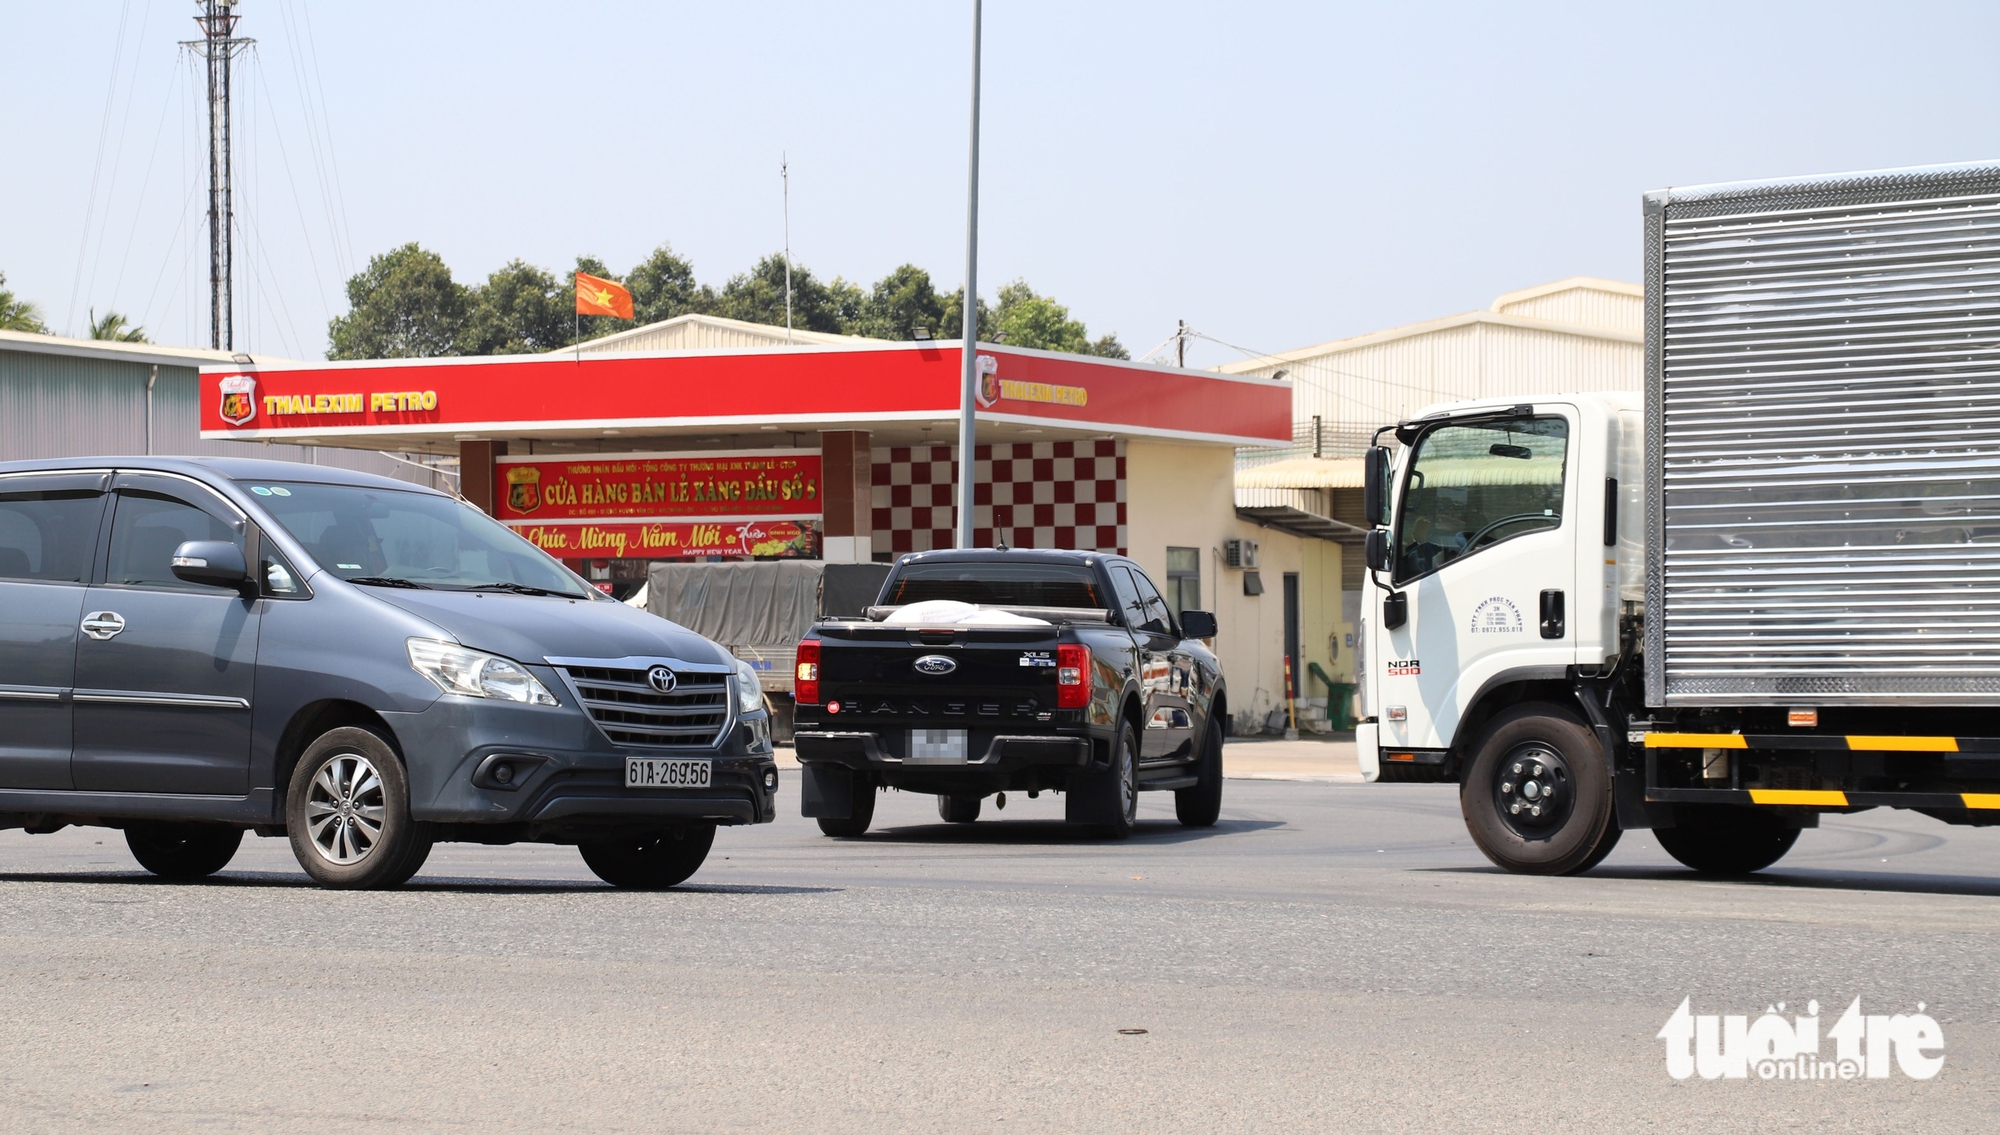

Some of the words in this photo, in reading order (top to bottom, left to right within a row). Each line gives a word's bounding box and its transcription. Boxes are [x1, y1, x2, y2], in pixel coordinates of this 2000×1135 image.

[999, 379, 1053, 403] THALEXIM
[1053, 384, 1088, 407] PETRO
[263, 393, 364, 416] THALEXIM
[370, 390, 437, 412] PETRO
[679, 463, 687, 472] TY
[545, 475, 578, 506] CỬA
[582, 478, 628, 504] HÀNG
[631, 476, 666, 503] BÁN
[670, 472, 690, 502] LẺ
[693, 474, 741, 502] XĂNG
[744, 471, 779, 502] DẦU
[781, 471, 804, 501] SỐ
[807, 478, 816, 500] 5
[528, 526, 568, 549] Chúc
[569, 526, 627, 558] Mừng
[629, 523, 678, 549] Năm
[680, 524, 722, 548] Mới
[924, 660, 946, 671] Ford
[1388, 660, 1420, 668] NQR
[1388, 668, 1421, 676] 500
[841, 701, 1034, 716] RANGER
[630, 761, 709, 785] 61A-269.56
